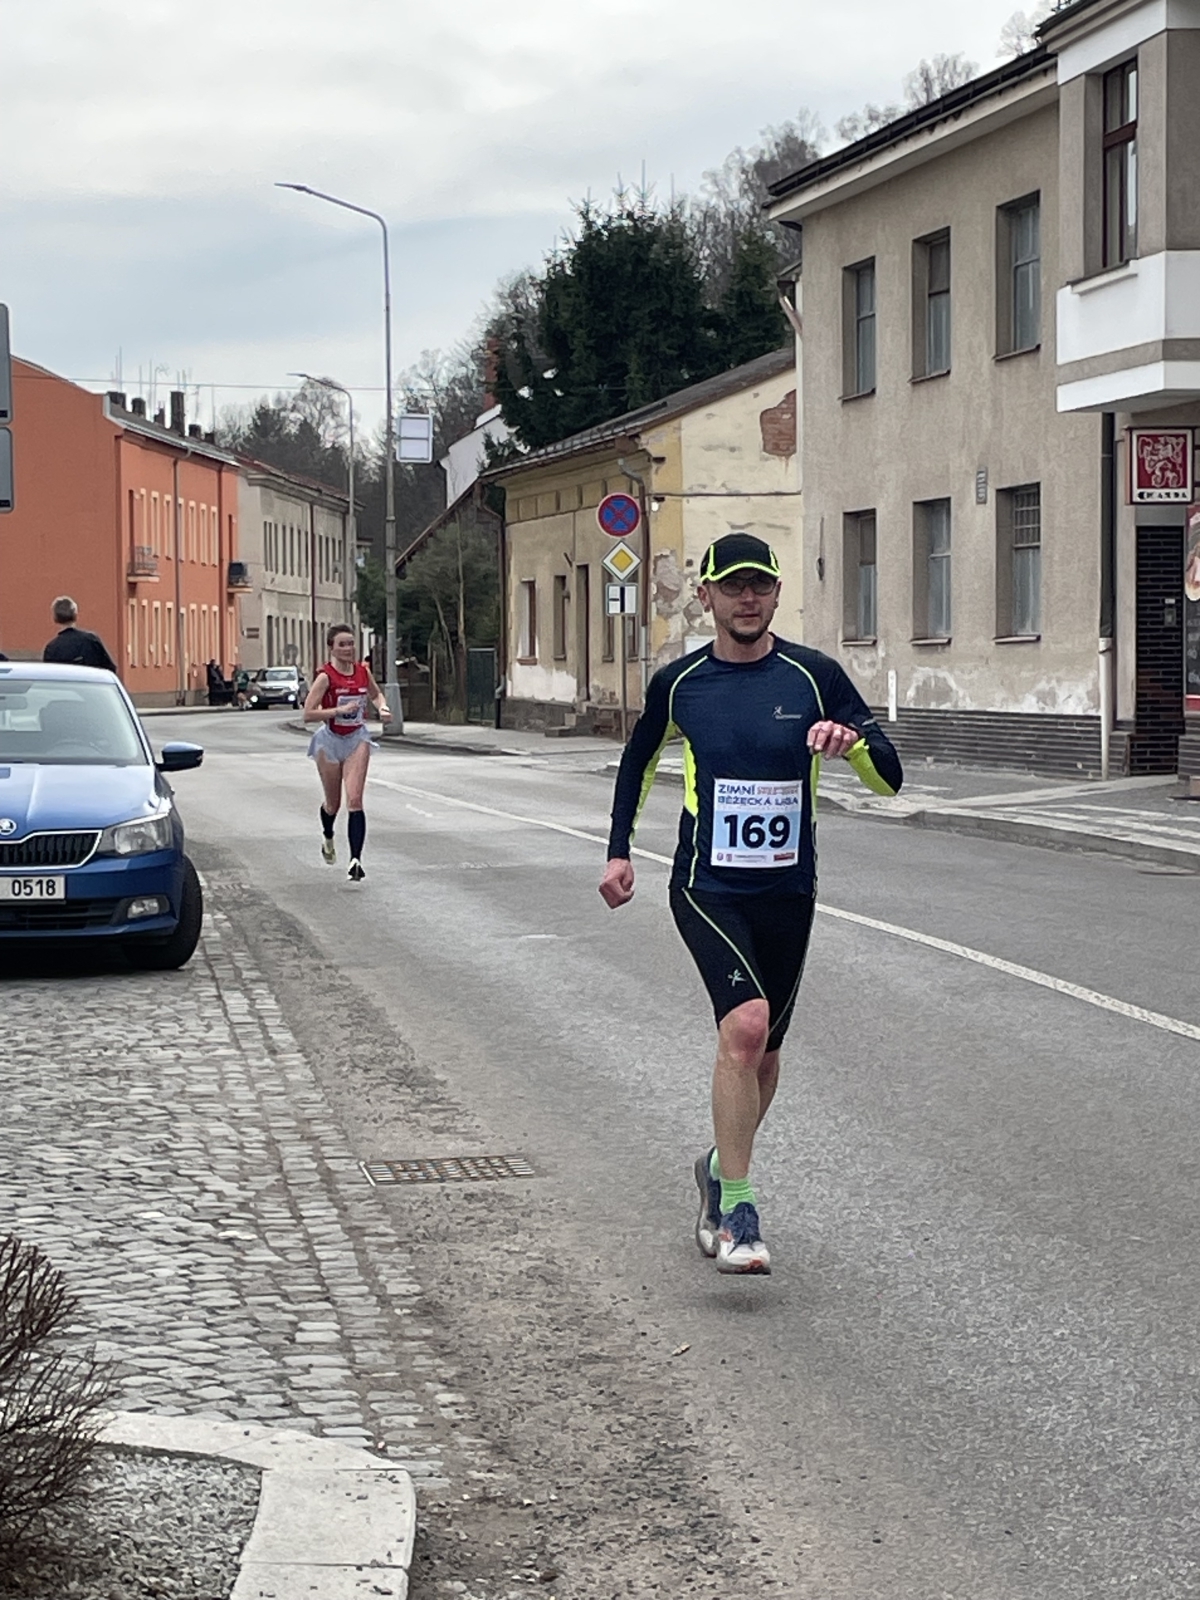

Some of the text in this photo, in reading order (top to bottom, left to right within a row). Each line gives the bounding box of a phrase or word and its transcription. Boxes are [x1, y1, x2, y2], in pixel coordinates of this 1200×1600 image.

[718, 784, 756, 795] ZIMNÍ
[724, 814, 790, 849] 169
[11, 879, 56, 897] 0518
